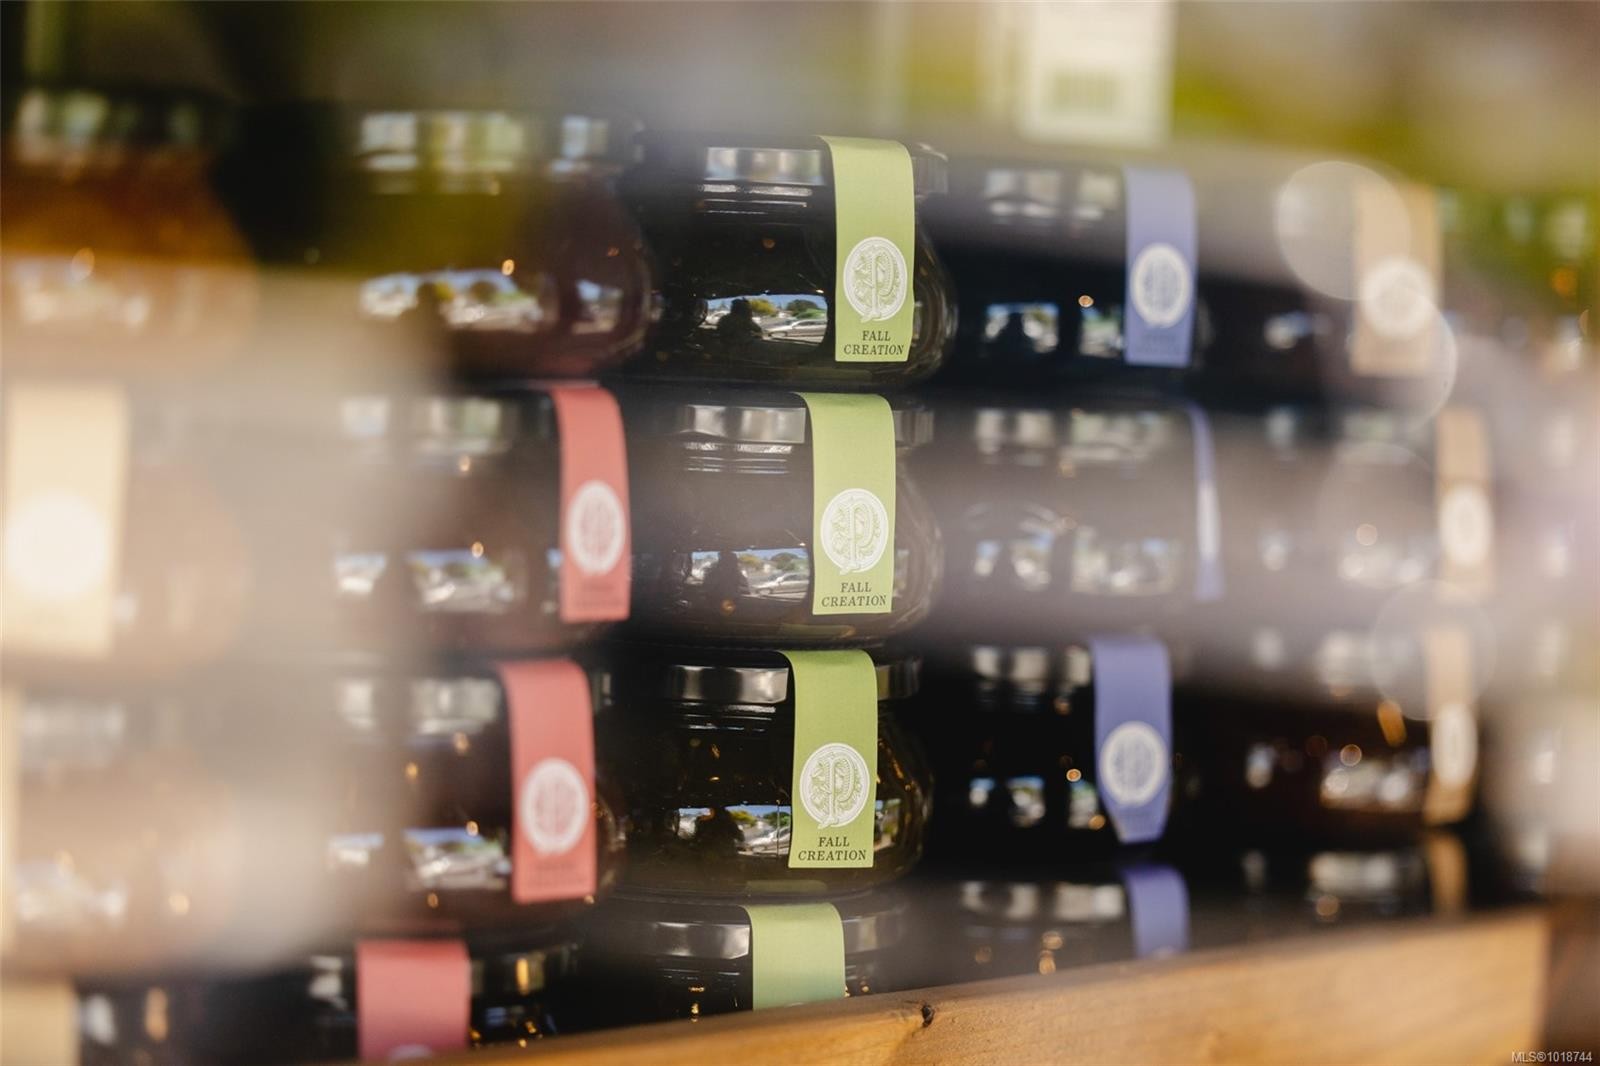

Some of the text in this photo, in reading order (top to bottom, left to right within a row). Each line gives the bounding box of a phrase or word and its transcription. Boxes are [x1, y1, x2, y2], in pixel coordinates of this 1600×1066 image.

[862, 330, 891, 341] FALL
[843, 344, 905, 355] CREATION
[840, 582, 872, 593] FALL
[821, 595, 887, 607] CREATION
[818, 836, 850, 847] FALL
[798, 850, 867, 861] CREATION
